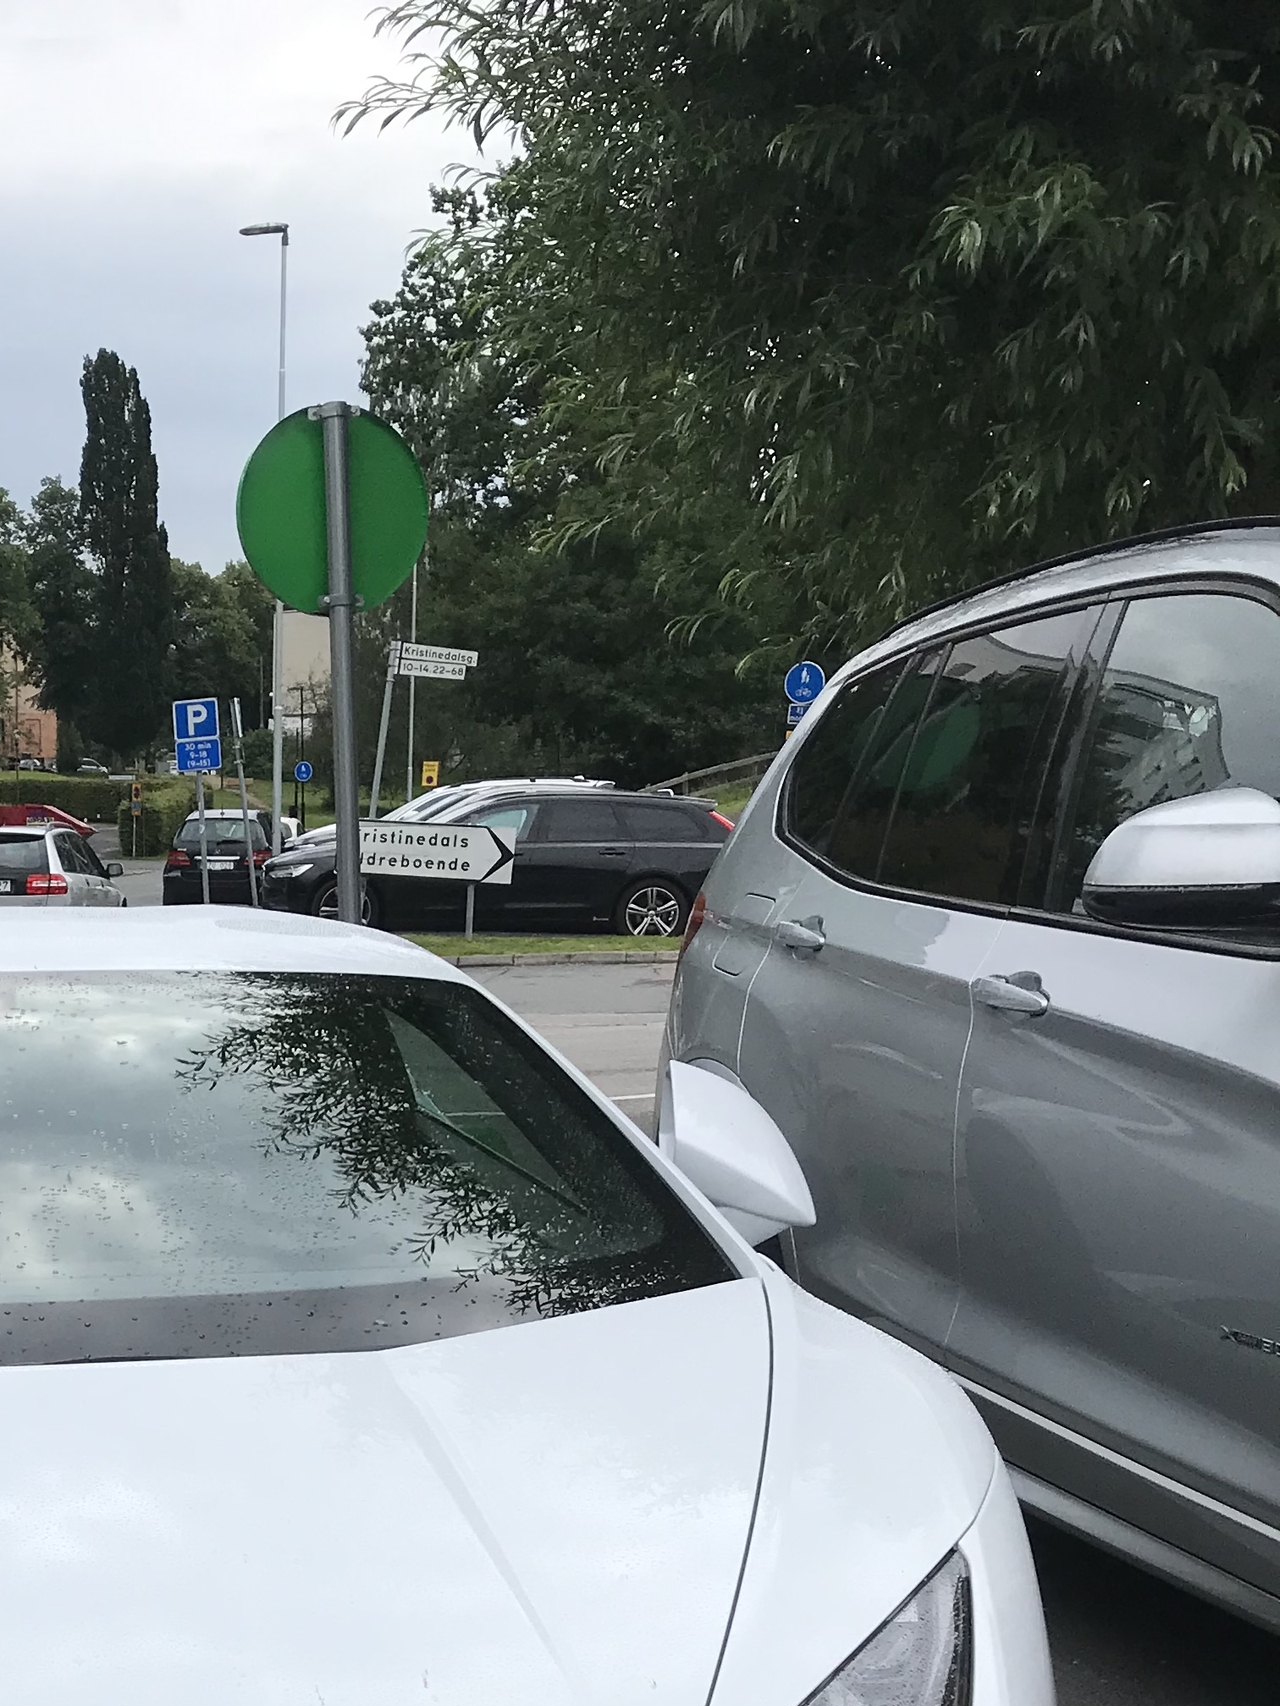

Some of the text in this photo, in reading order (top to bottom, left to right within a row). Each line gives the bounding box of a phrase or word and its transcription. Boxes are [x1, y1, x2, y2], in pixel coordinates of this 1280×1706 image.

[404, 646, 476, 665] Kristinedalsg.
[186, 703, 208, 736] P
[185, 741, 212, 751] 30 min
[189, 750, 207, 759] 9-18
[359, 828, 469, 848] ristinedals
[360, 852, 470, 872] ldreboende
